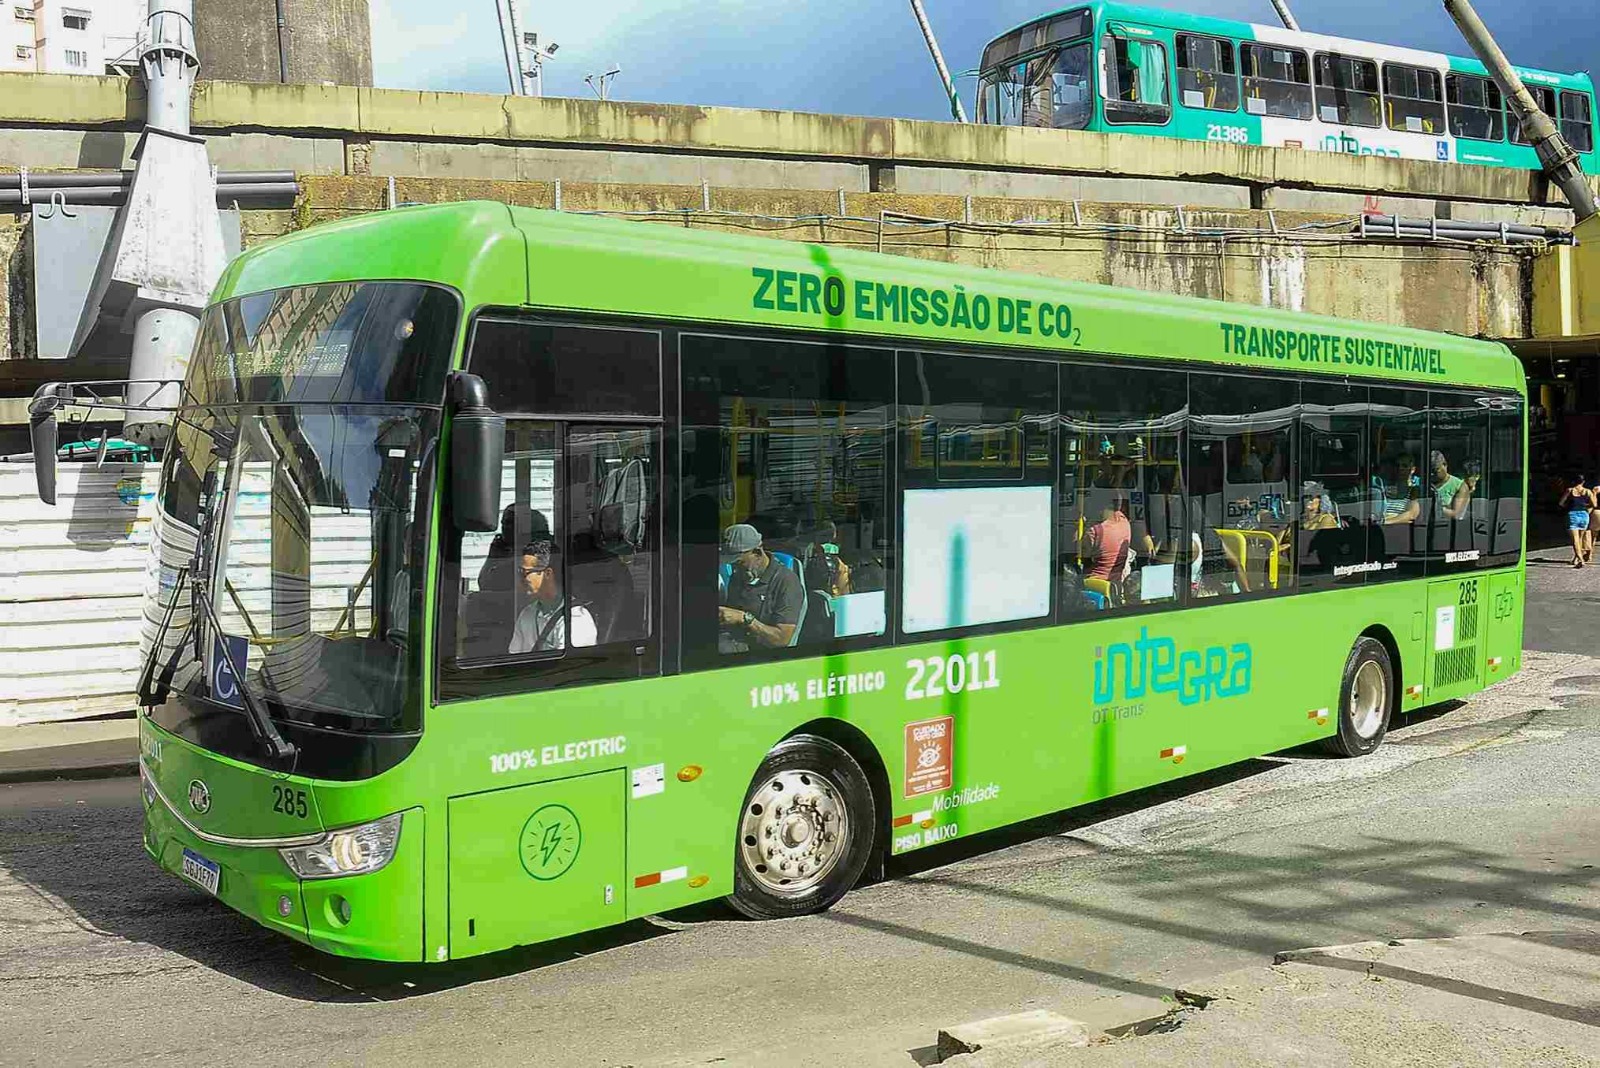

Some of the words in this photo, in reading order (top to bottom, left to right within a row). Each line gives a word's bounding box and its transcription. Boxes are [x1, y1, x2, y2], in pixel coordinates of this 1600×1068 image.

[1206, 123, 1248, 143] 21386
[752, 266, 845, 317] ZERO
[854, 280, 990, 331] EMISSÃO
[997, 297, 1032, 335] DE
[1220, 322, 1341, 363] TRANSPORTE
[1459, 579, 1478, 605] 285
[750, 682, 799, 708] 100%
[806, 670, 886, 700] ELÉTRICO
[904, 650, 1000, 701] 22011
[1111, 703, 1144, 722] Trans
[489, 748, 537, 775] 100%
[541, 735, 627, 766] ELECTRIC
[272, 784, 308, 819] 285
[931, 781, 1000, 813] Mobilidade
[894, 832, 921, 853] PISO
[924, 823, 958, 844] BAIXO
